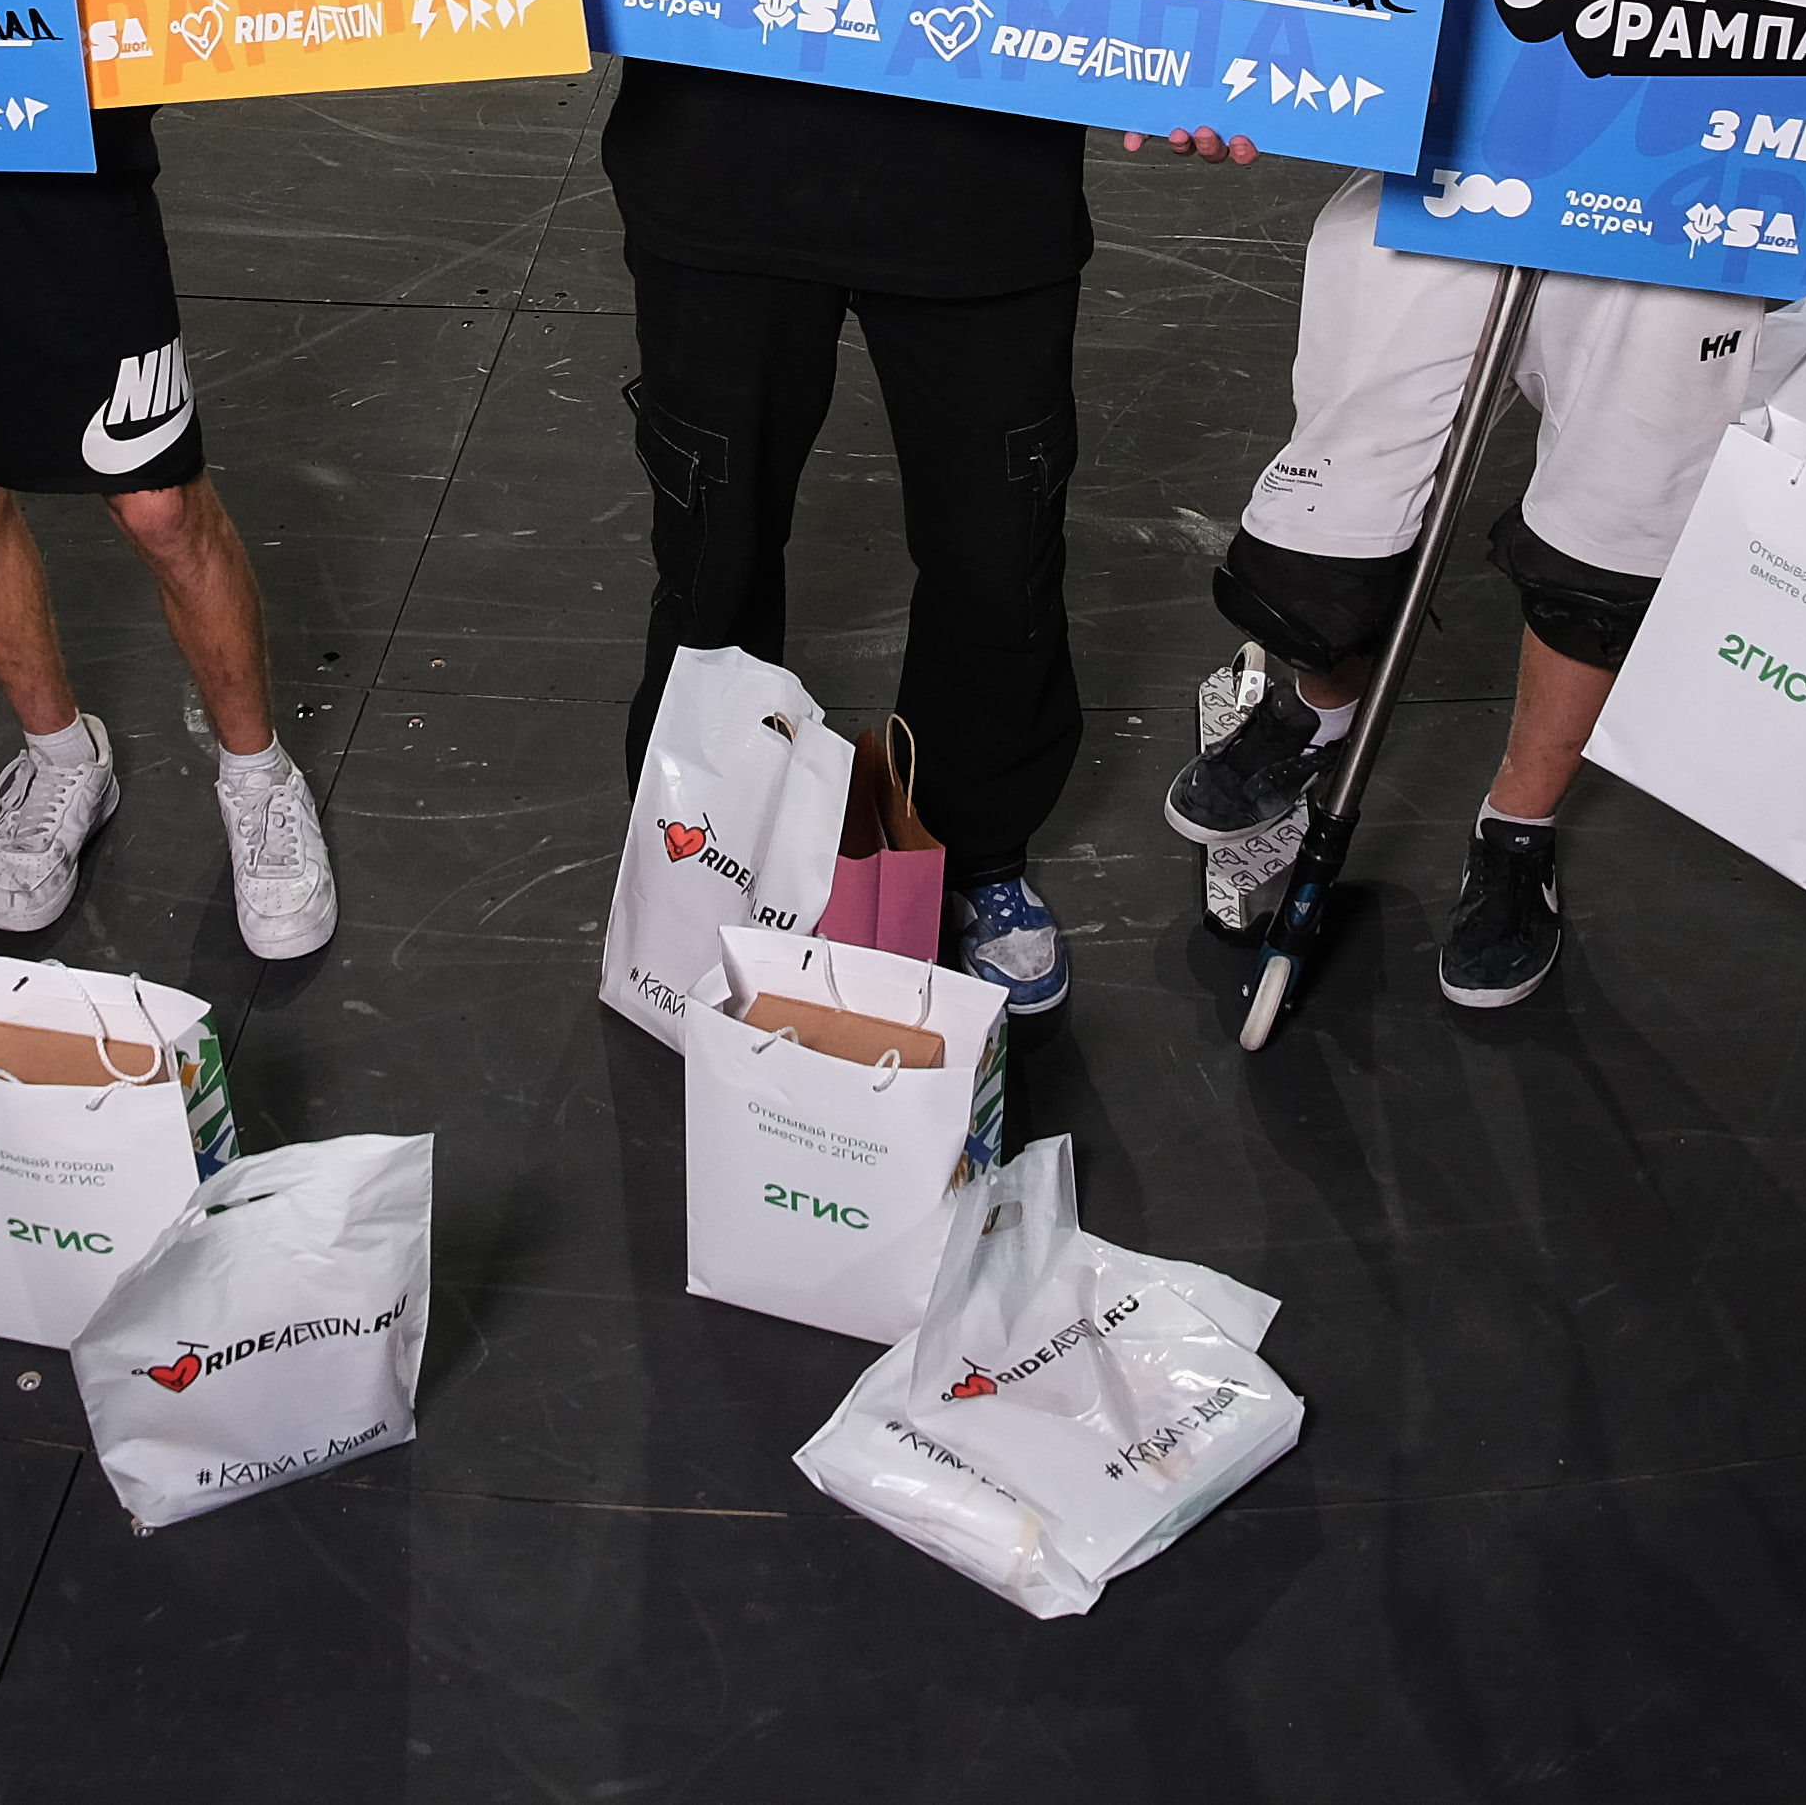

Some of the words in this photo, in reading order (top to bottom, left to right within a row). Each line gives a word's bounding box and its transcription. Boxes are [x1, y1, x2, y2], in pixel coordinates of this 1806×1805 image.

[1701, 110, 1738, 150] 3
[1699, 329, 1742, 362] HH
[1275, 462, 1317, 479] ANSEN
[1750, 564, 1800, 598] вместе
[748, 1101, 826, 1138] Открывай
[831, 1133, 888, 1154] города
[758, 1123, 814, 1149] вместе
[818, 1144, 827, 1153] с
[832, 1146, 877, 1166] 2ГИС
[45, 1174, 54, 1183] с
[59, 1174, 106, 1187] 2ГИС
[55, 1161, 114, 1173] города
[764, 1183, 870, 1229] 2ГИС
[7, 1218, 114, 1254] 2ГИС
